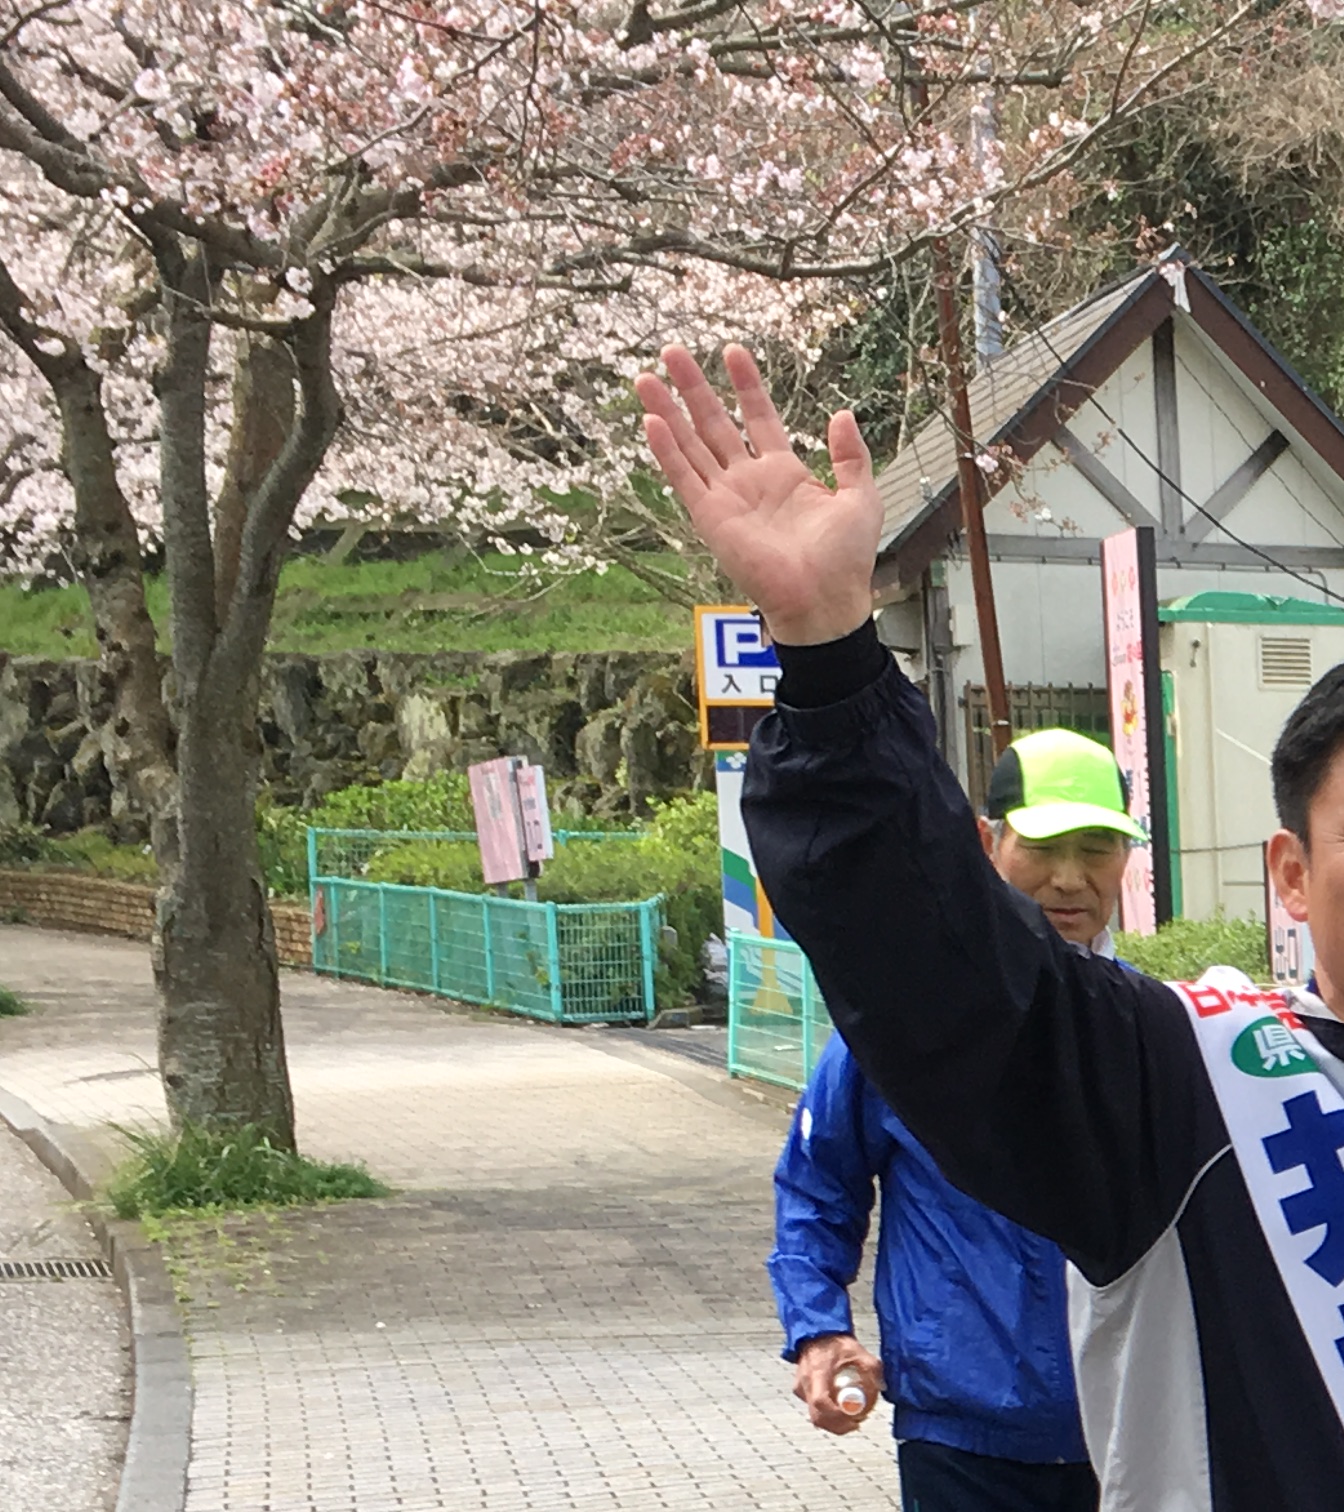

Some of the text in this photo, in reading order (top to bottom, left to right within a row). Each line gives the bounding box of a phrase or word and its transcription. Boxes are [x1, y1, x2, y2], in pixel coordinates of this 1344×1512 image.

[723, 623, 768, 665] P
[721, 674, 779, 694] 入口
[1252, 1024, 1306, 1071] 県
